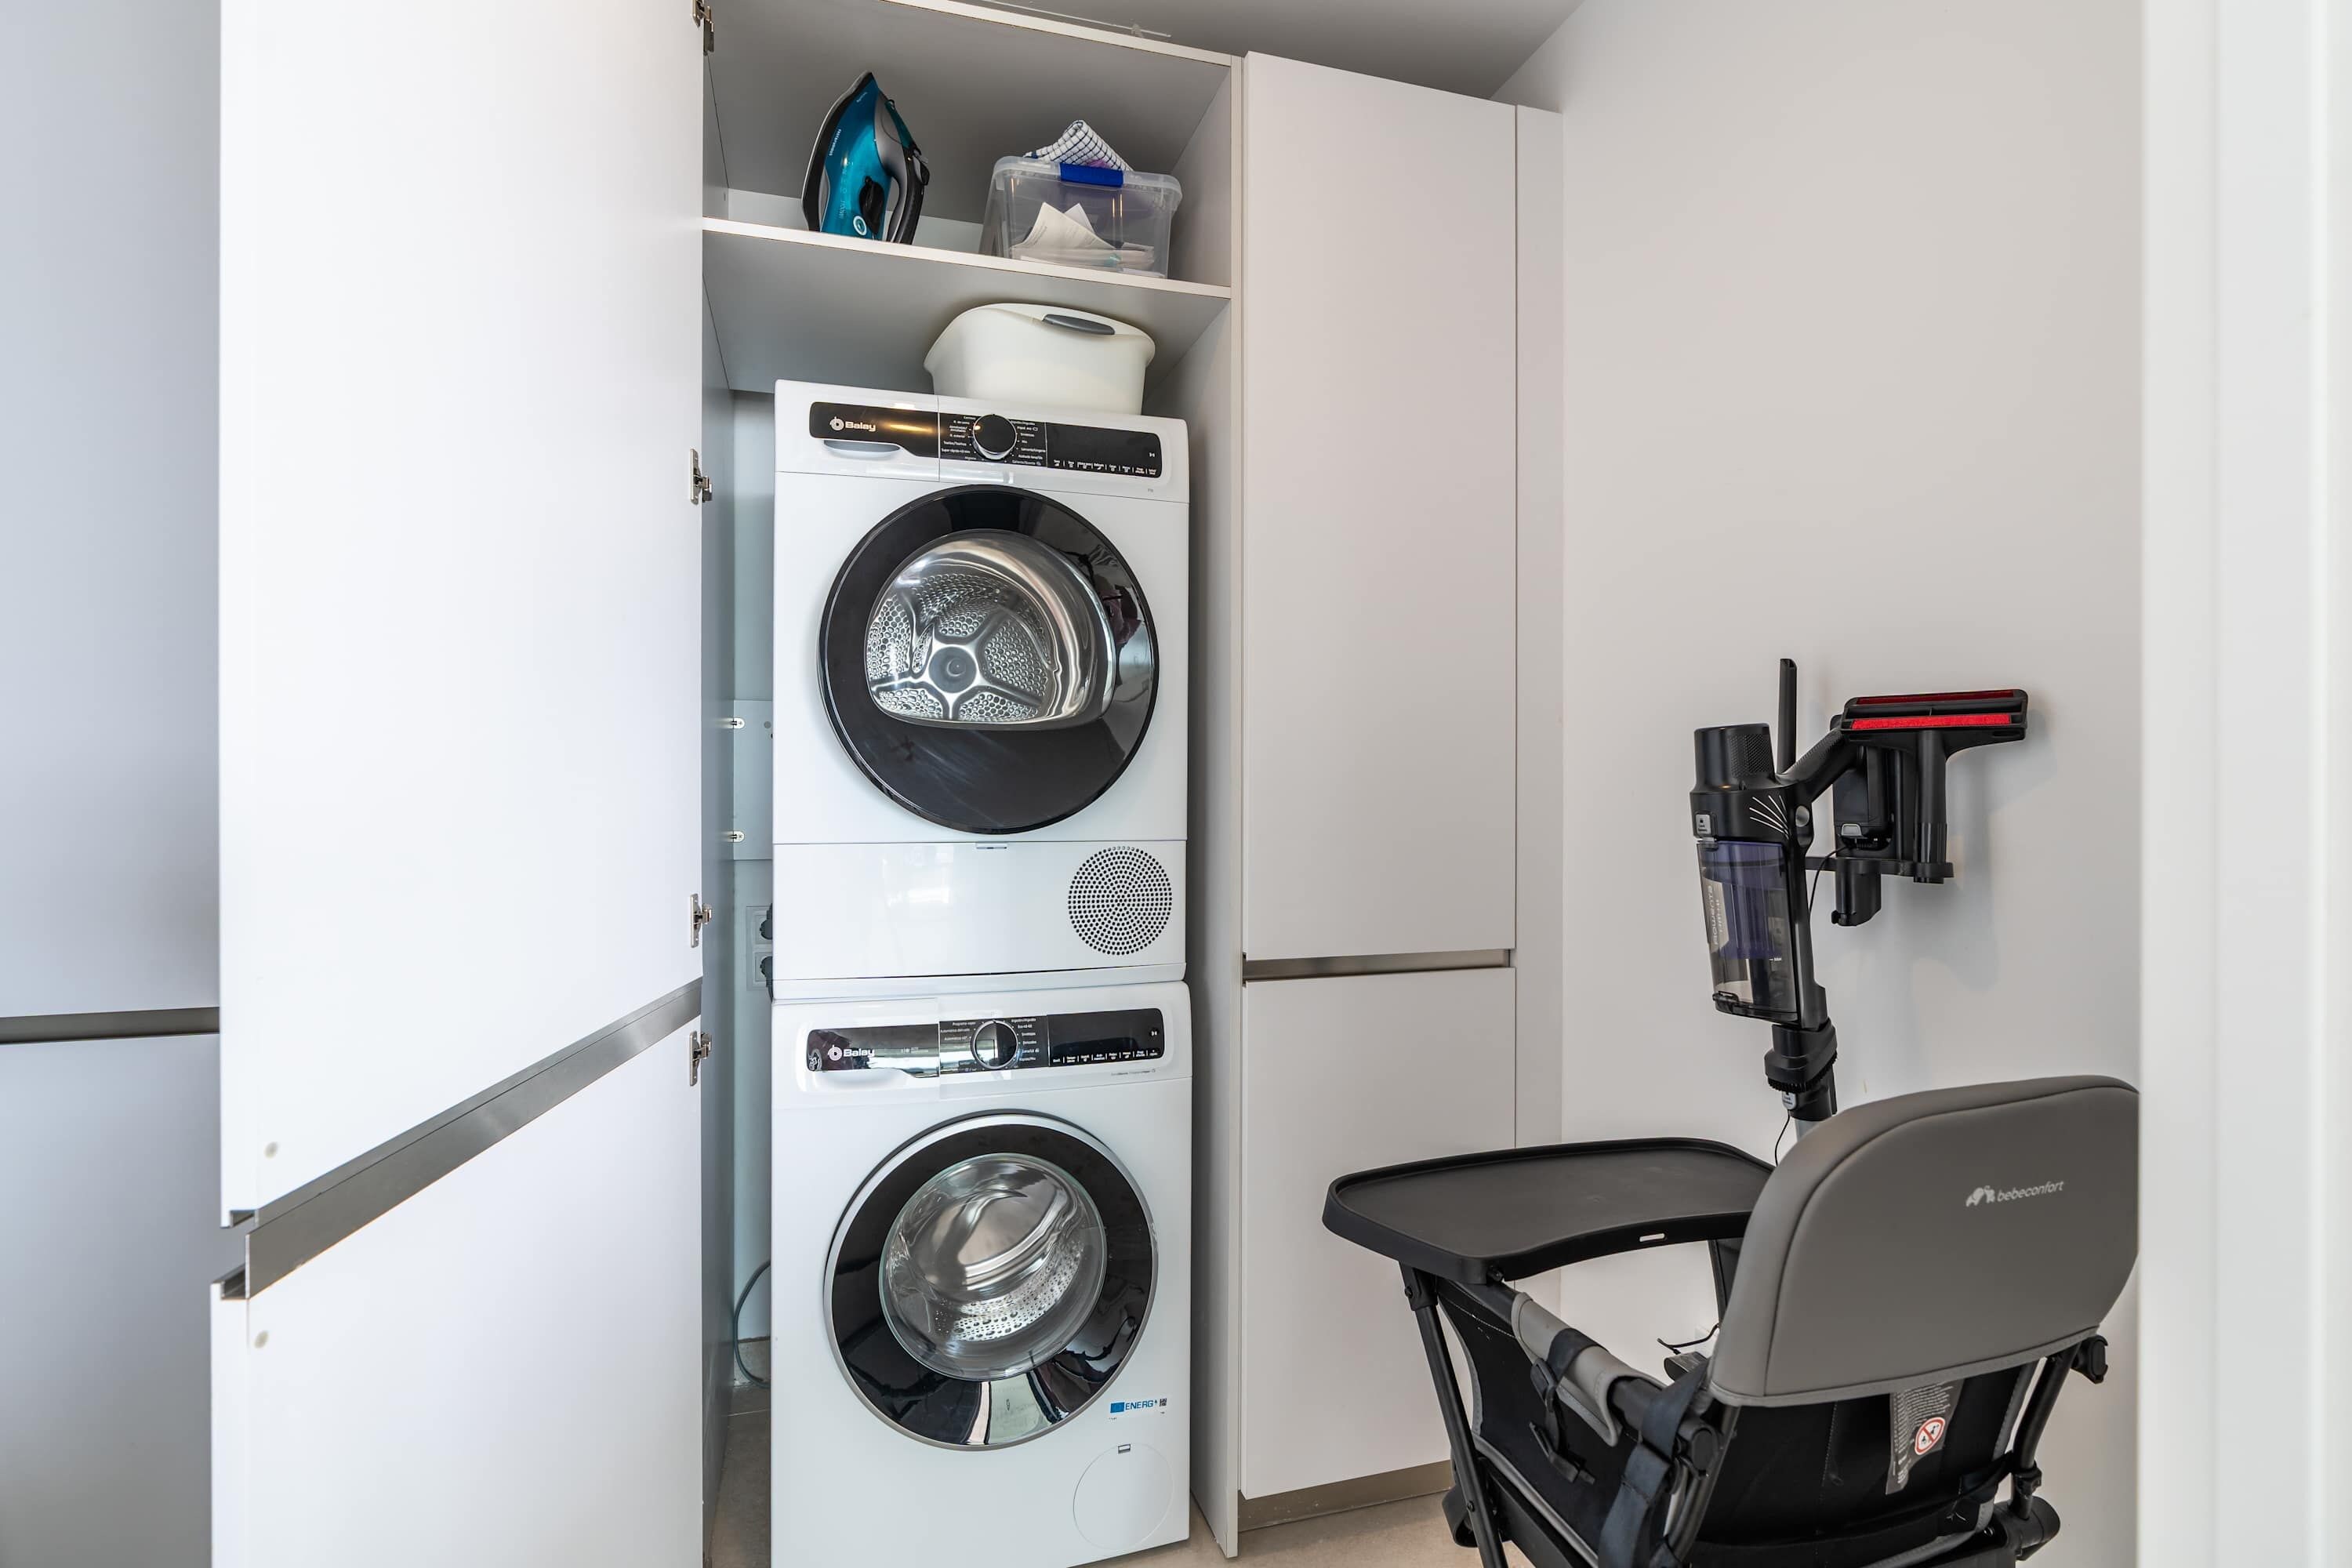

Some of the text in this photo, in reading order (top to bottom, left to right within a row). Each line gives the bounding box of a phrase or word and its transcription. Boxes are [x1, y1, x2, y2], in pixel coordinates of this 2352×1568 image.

[845, 421, 877, 432] Balay
[843, 1048, 875, 1058] Balay
[1997, 1181, 2064, 1203] bebeconfort
[1126, 1400, 1154, 1410] ENERG
